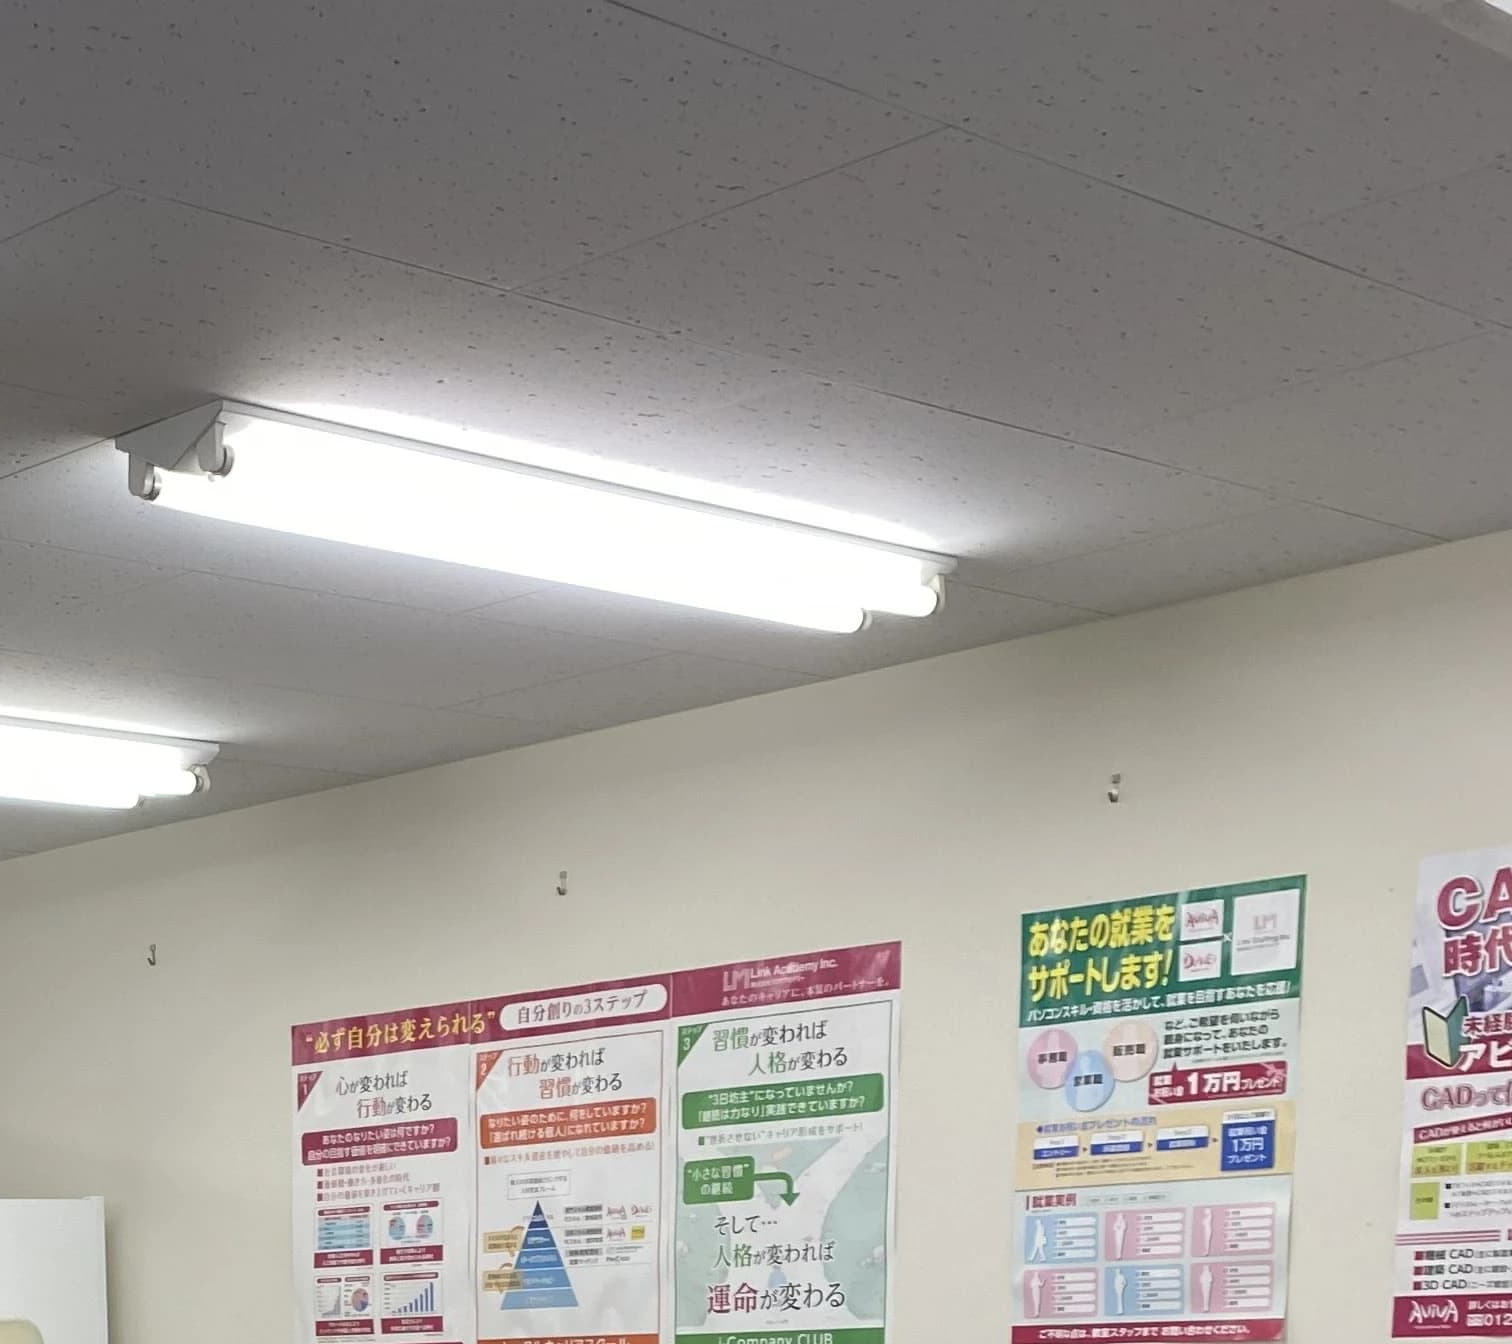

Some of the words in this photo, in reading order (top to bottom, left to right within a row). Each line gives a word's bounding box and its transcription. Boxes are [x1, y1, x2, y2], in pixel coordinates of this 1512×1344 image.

[1029, 904, 1176, 957] あなたの就業を
[1028, 949, 1173, 1002] サポートします!
[518, 990, 648, 1024] 自分創りの3ステップ
[683, 1038, 690, 1050] 3
[713, 1020, 827, 1051] 習慣が変われば
[508, 1048, 605, 1077] 行動が変われば
[748, 1047, 848, 1076] 人格が変わる
[1112, 1044, 1146, 1056] 販売職
[480, 1065, 486, 1075] 2
[302, 1084, 308, 1096] 1
[337, 1071, 408, 1096] 心が変われば
[539, 1073, 623, 1099] 習慣が変わる
[357, 1094, 432, 1119] 行動が変わる
[1231, 1137, 1264, 1152] 1万円
[1227, 1154, 1266, 1163] プレゼント
[714, 1241, 835, 1268] 人格が変われば
[1449, 1249, 1473, 1259] CAD
[1448, 1264, 1472, 1274] CAD
[1442, 1280, 1467, 1290] CAD
[708, 1282, 845, 1314] 運命が変わる
